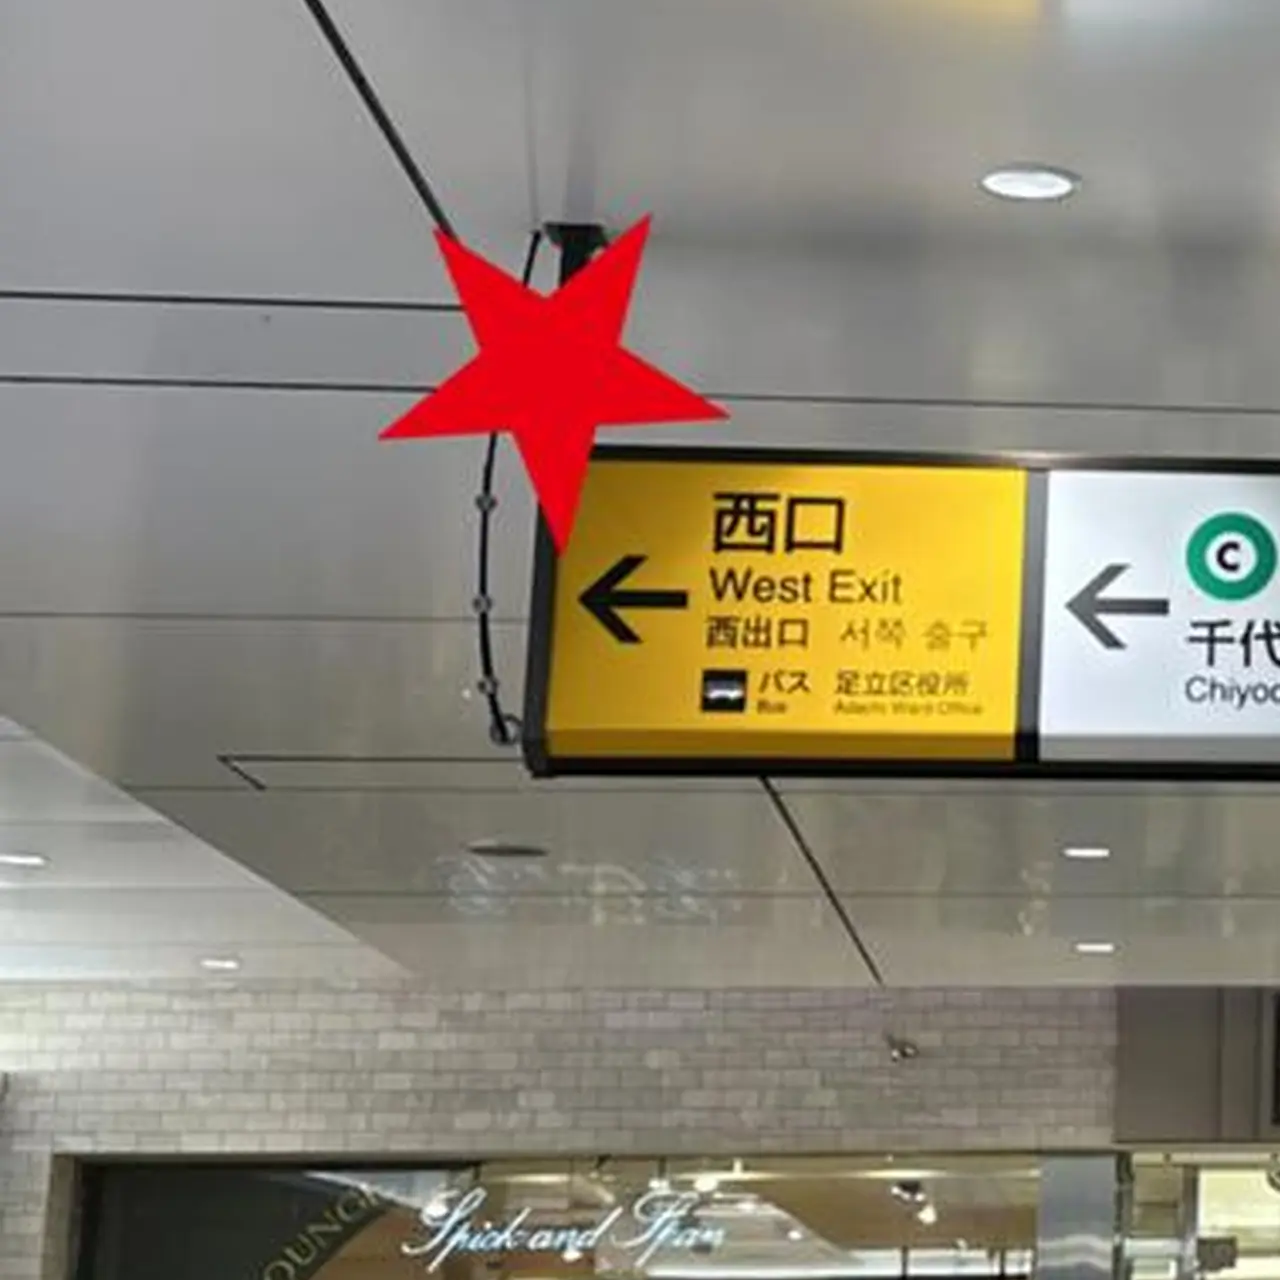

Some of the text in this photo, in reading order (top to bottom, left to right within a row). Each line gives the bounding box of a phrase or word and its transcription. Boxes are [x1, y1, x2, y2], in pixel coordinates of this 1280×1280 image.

[713, 492, 846, 555] 西口
[1215, 541, 1241, 572] C
[709, 568, 903, 605] West Exit
[706, 615, 810, 649] 西出口
[758, 670, 812, 695] バス
[526, 1205, 624, 1252] and
